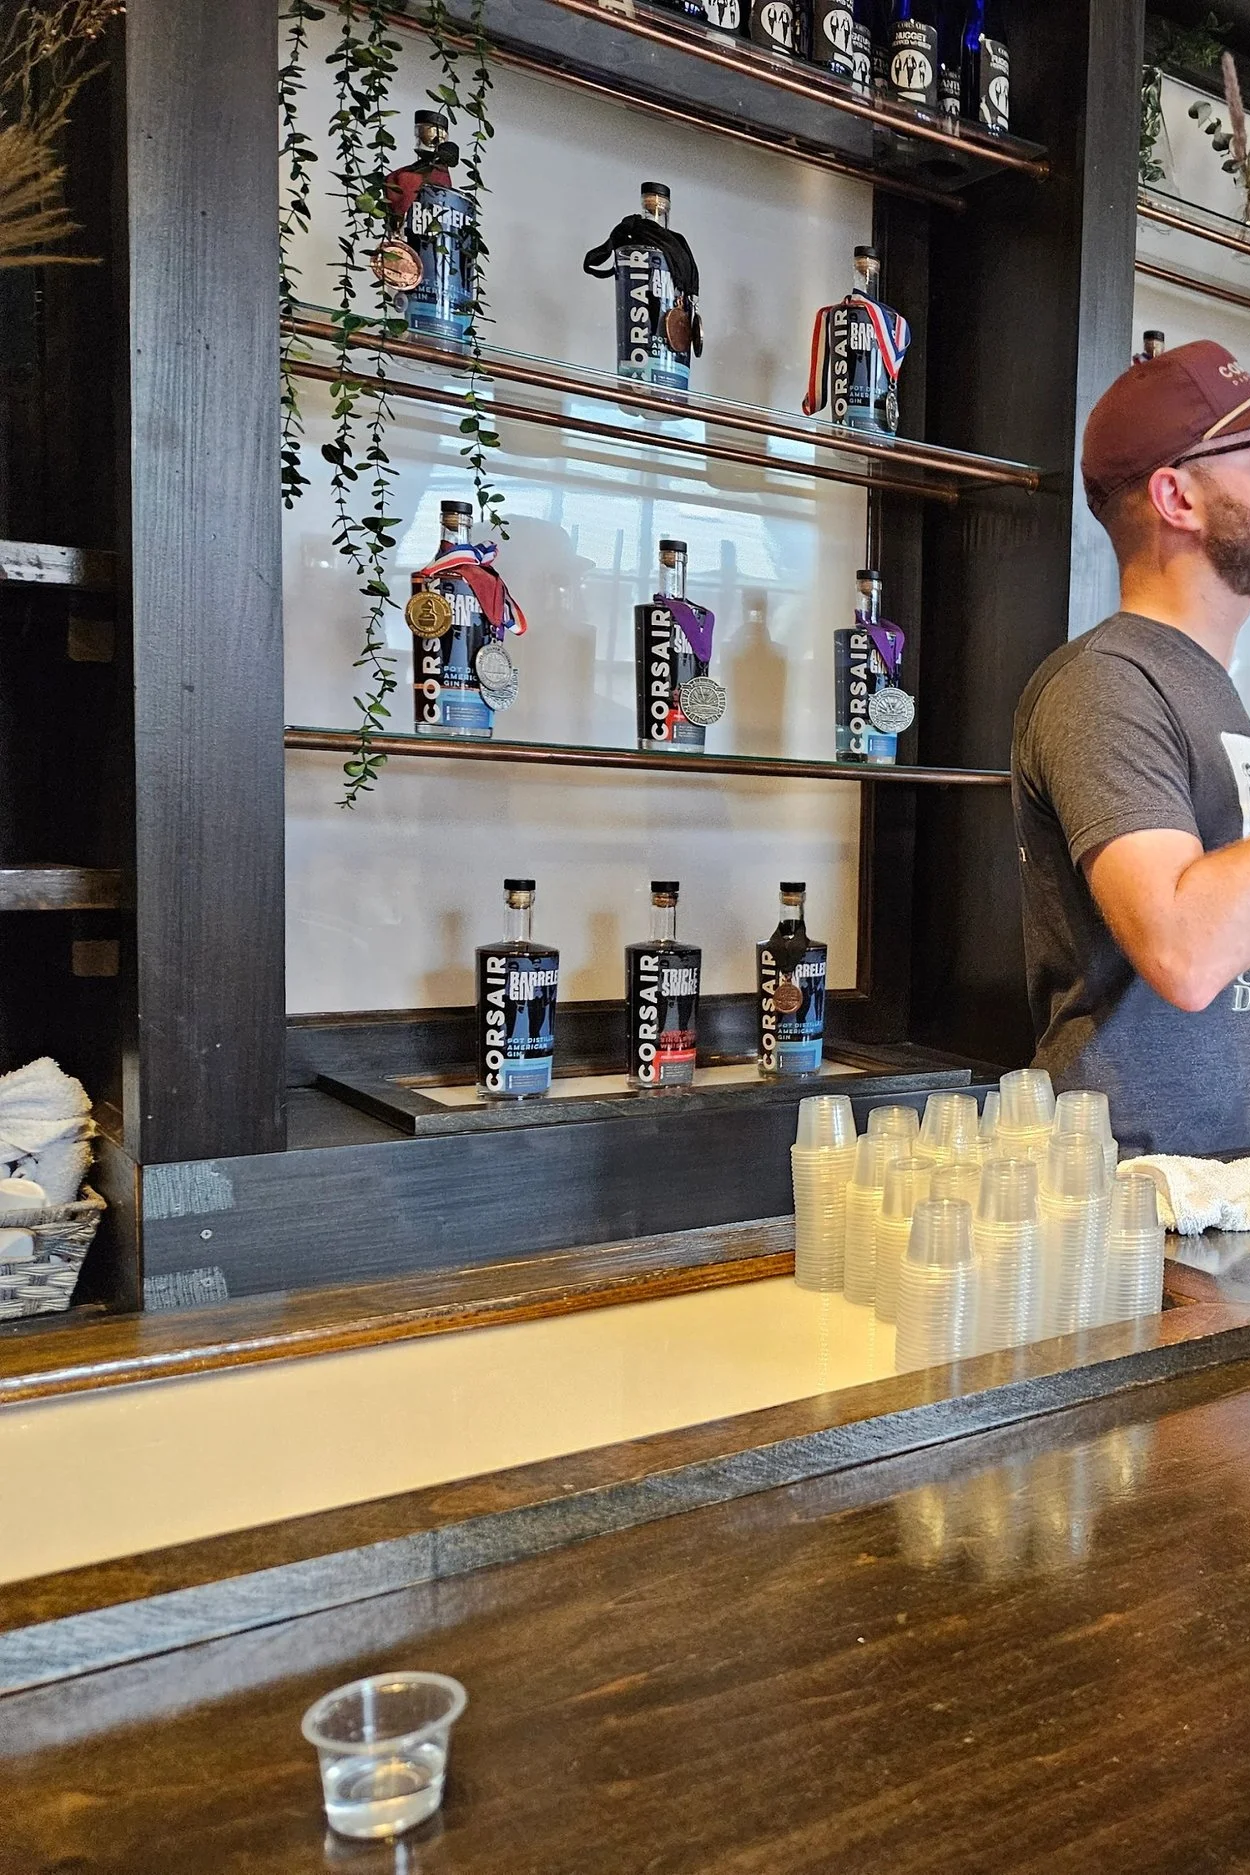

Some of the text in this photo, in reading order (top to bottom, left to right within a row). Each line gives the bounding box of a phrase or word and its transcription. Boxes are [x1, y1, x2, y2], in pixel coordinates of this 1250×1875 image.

[895, 31, 928, 43] NUGGET
[850, 337, 871, 352] GIN
[443, 665, 464, 673] POT
[651, 609, 671, 741] CORSAIR
[850, 634, 868, 754] CORSAIR
[661, 968, 698, 984] TRIPLE
[509, 985, 534, 1001] GIN
[661, 979, 697, 997] SMOKE
[486, 956, 506, 1092] CORSAIR
[639, 955, 659, 1082] CORSAIR
